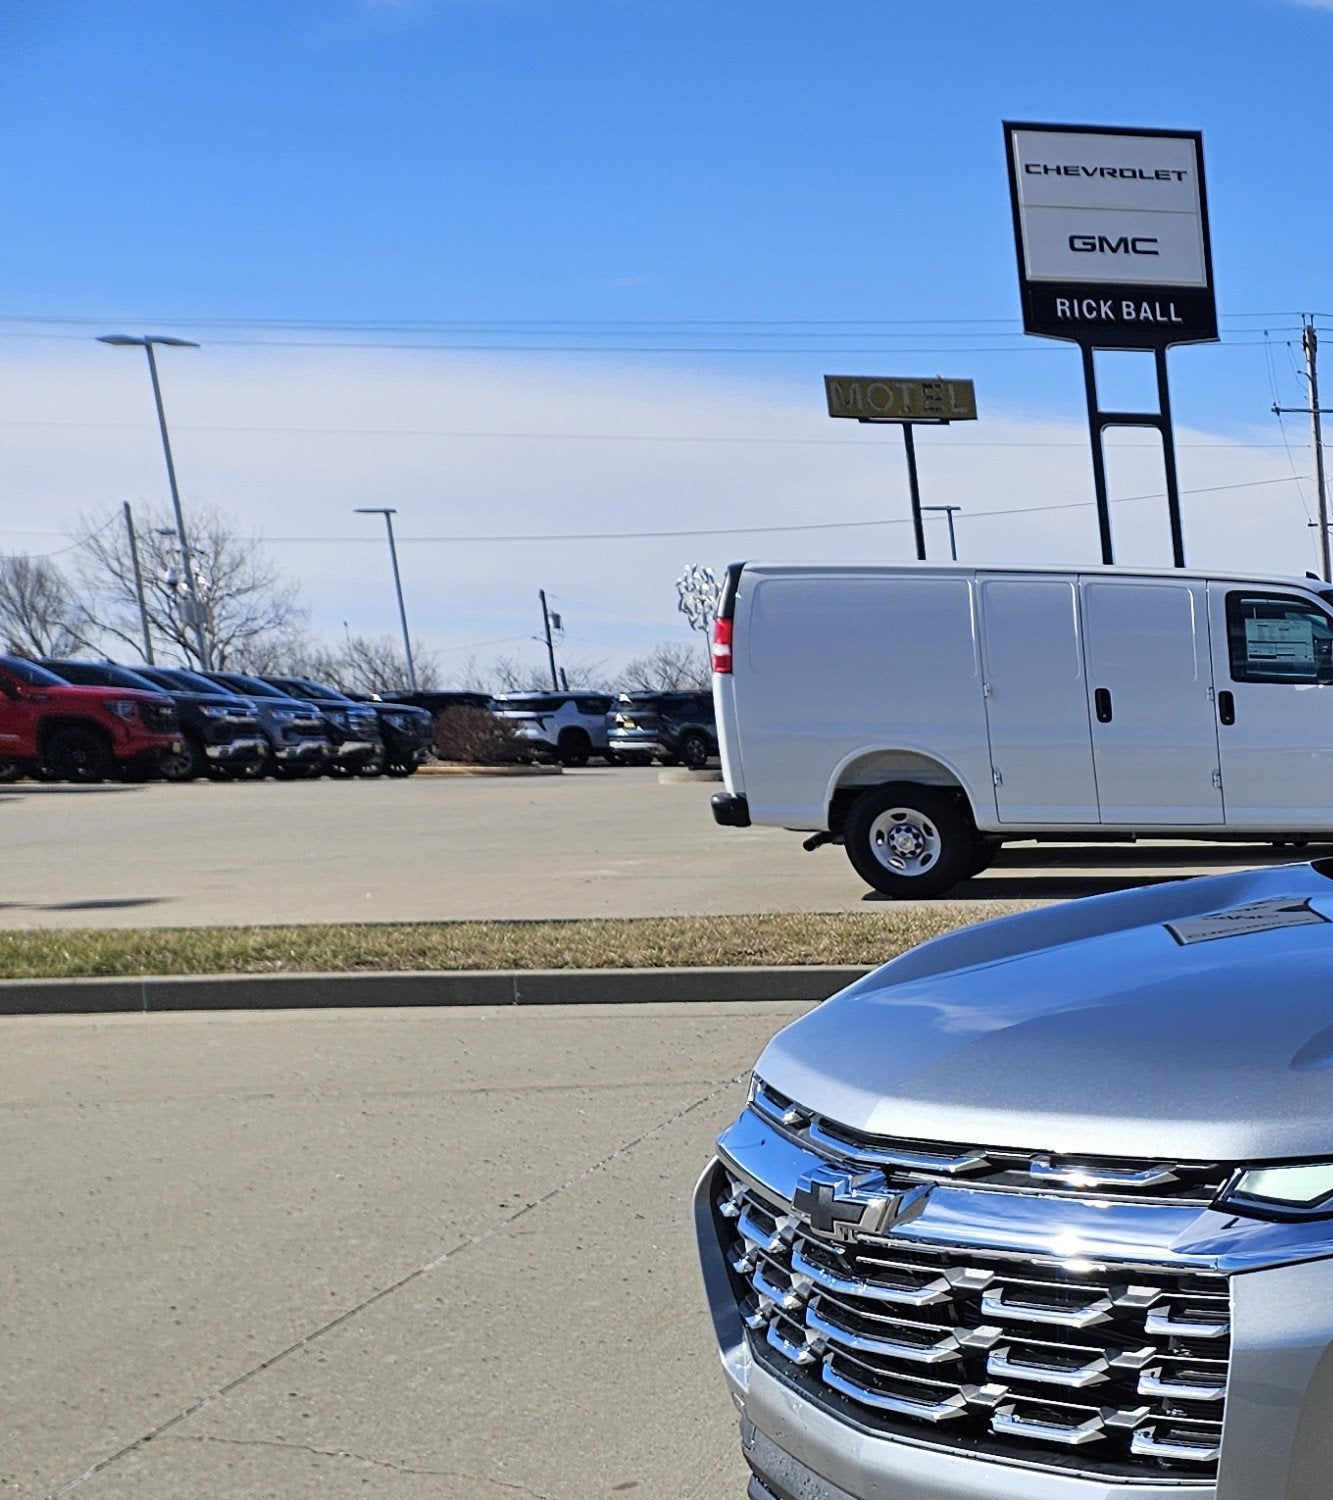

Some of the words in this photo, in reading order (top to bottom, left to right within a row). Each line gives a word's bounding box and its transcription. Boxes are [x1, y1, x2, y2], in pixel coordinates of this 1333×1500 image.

[1024, 162, 1188, 182] CHEVROLET
[1068, 234, 1159, 256] GMC
[1056, 297, 1115, 321] RICK
[1121, 300, 1183, 323] BALL
[830, 381, 969, 413] MOTEL
